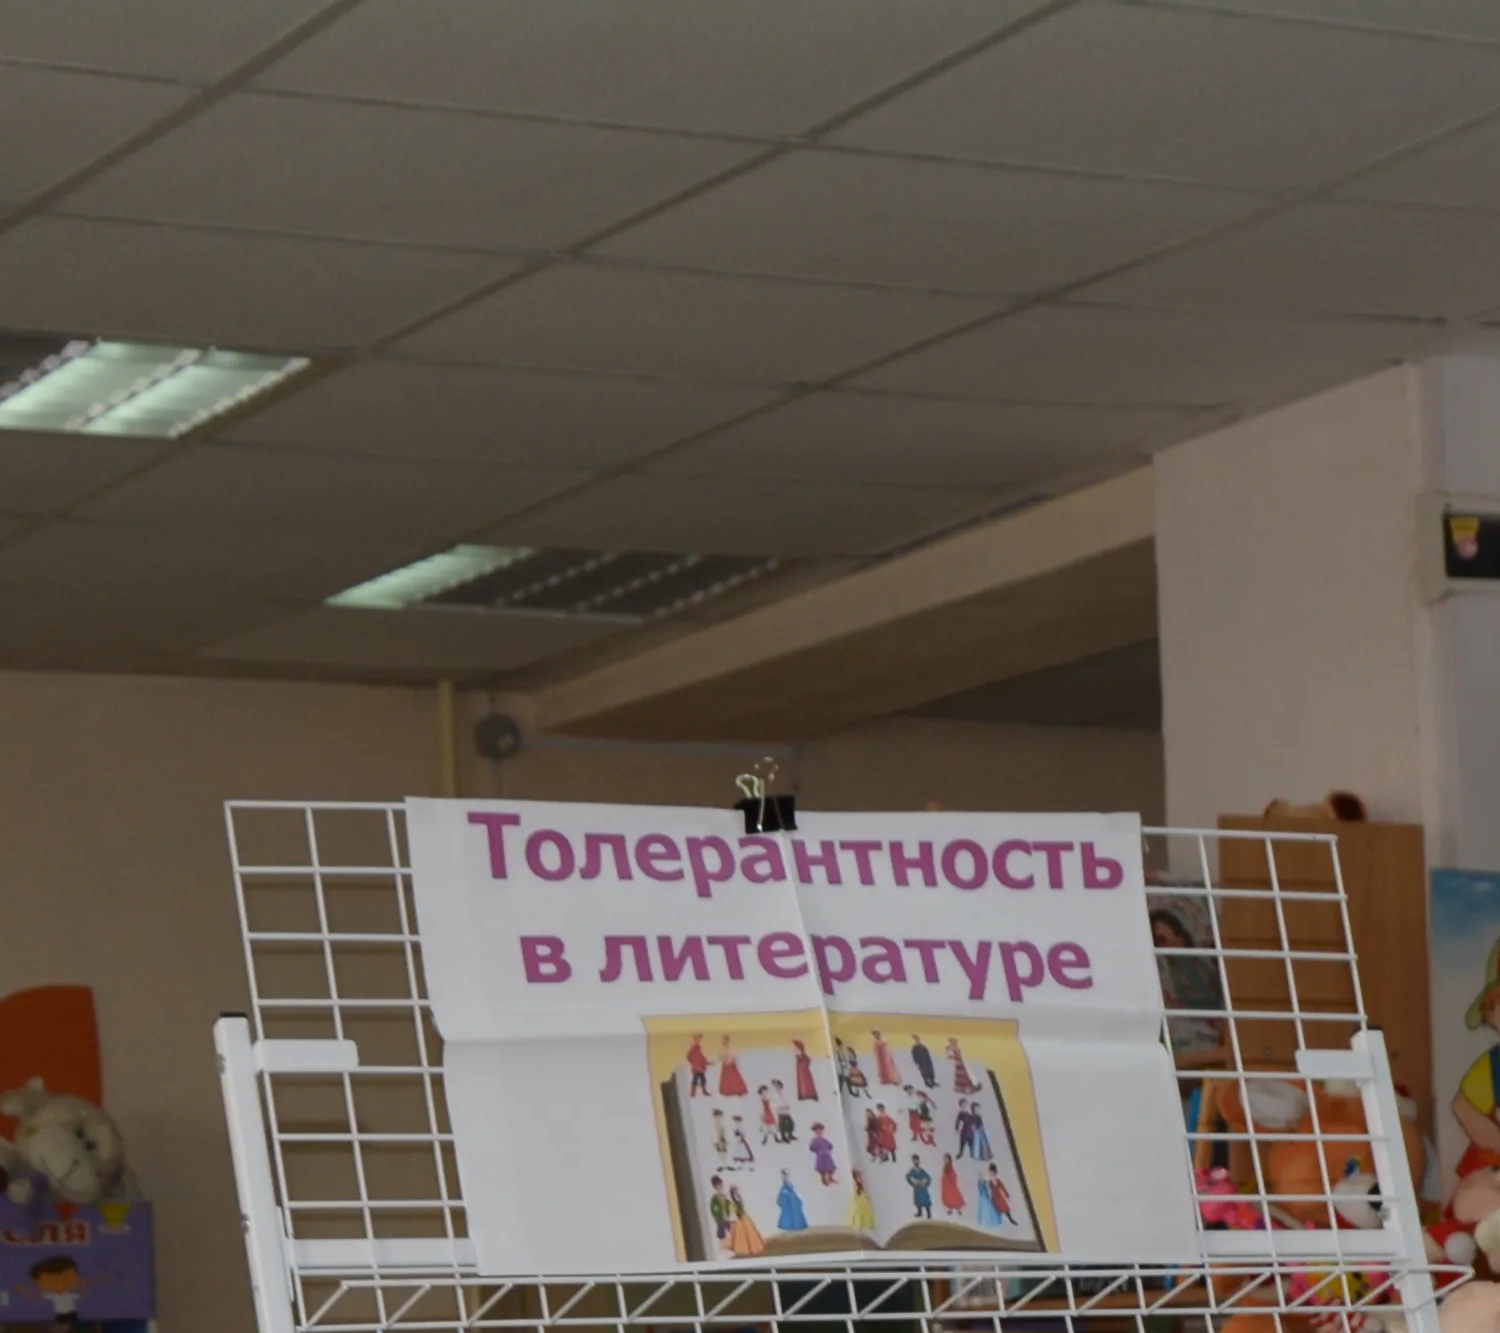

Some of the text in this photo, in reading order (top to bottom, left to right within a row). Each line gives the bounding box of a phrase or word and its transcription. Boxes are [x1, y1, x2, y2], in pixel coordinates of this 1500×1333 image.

[467, 811, 1125, 899] Толерантность
[519, 930, 1093, 1002] в литературе
